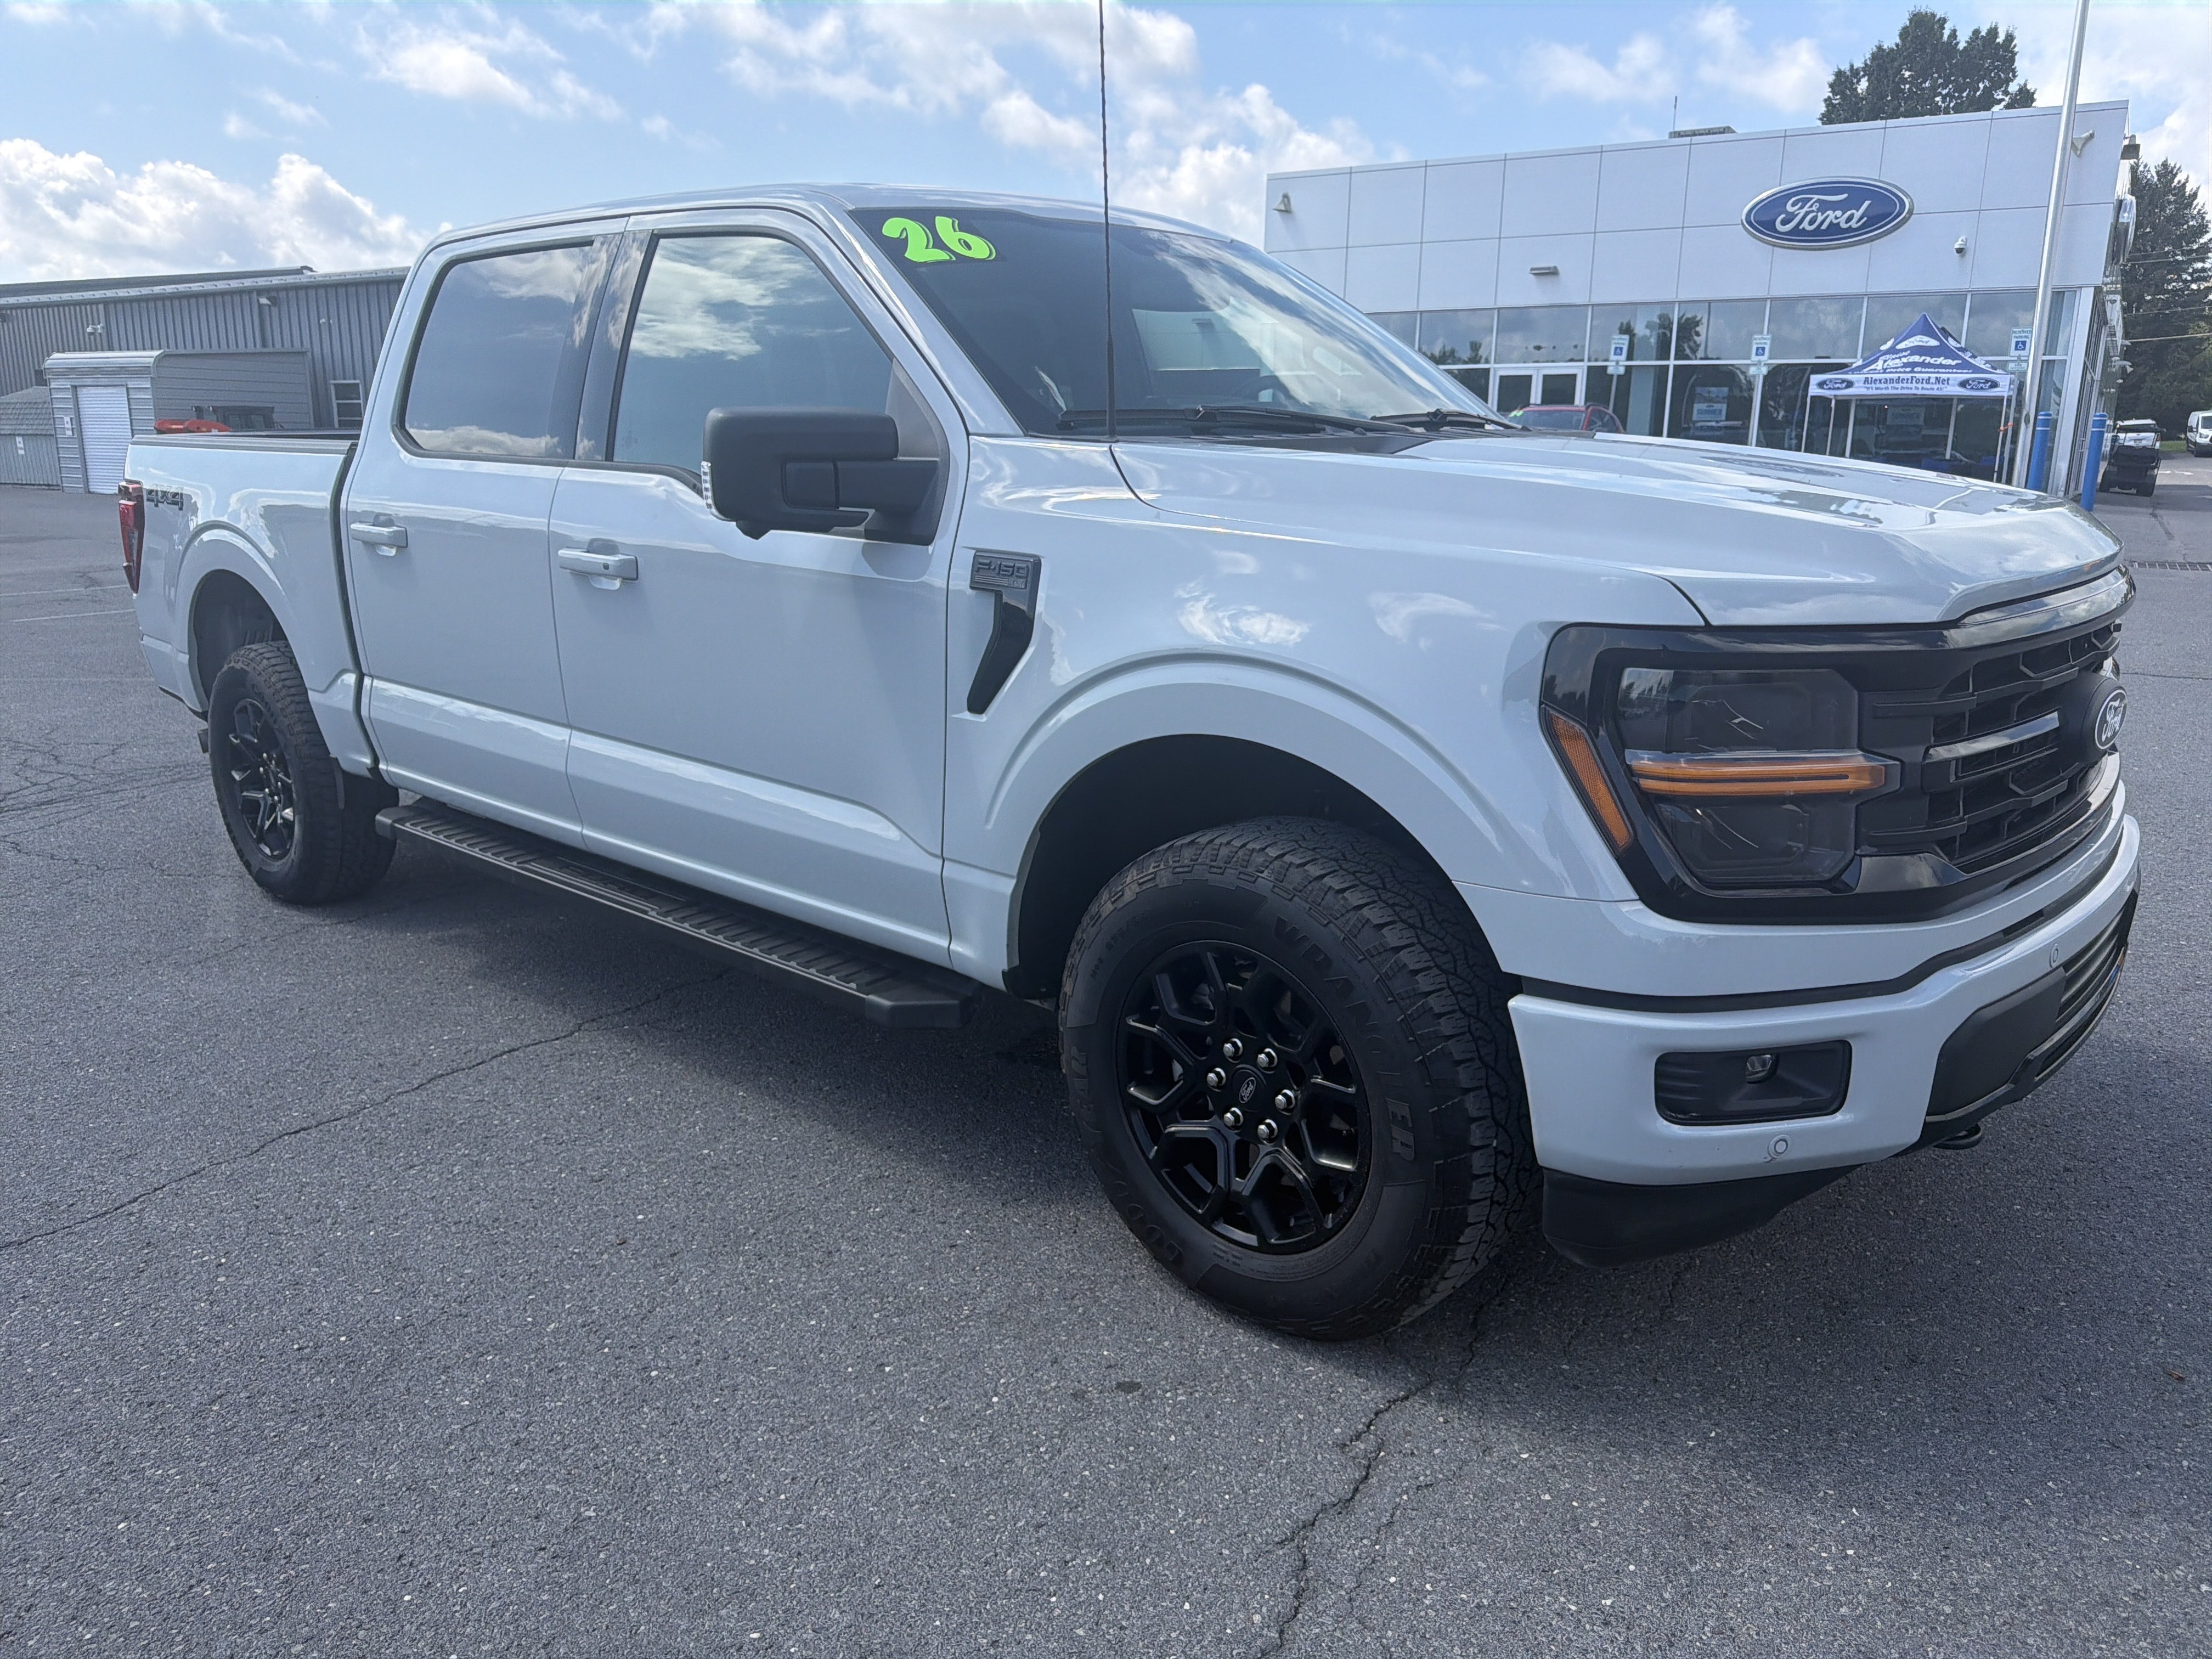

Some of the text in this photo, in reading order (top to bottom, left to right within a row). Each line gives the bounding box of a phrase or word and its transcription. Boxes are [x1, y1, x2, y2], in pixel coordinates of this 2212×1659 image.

[1775, 193, 1872, 233] Ford
[882, 216, 996, 263] 26
[1862, 355, 1962, 372] Alexander
[1823, 380, 1848, 389] Ford
[1863, 375, 1950, 385] AlexanderFord.Net
[1966, 380, 1991, 389] Ford
[975, 559, 1029, 578] F-150
[2101, 698, 2125, 742] Ford
[1241, 1081, 1254, 1101] Ford
